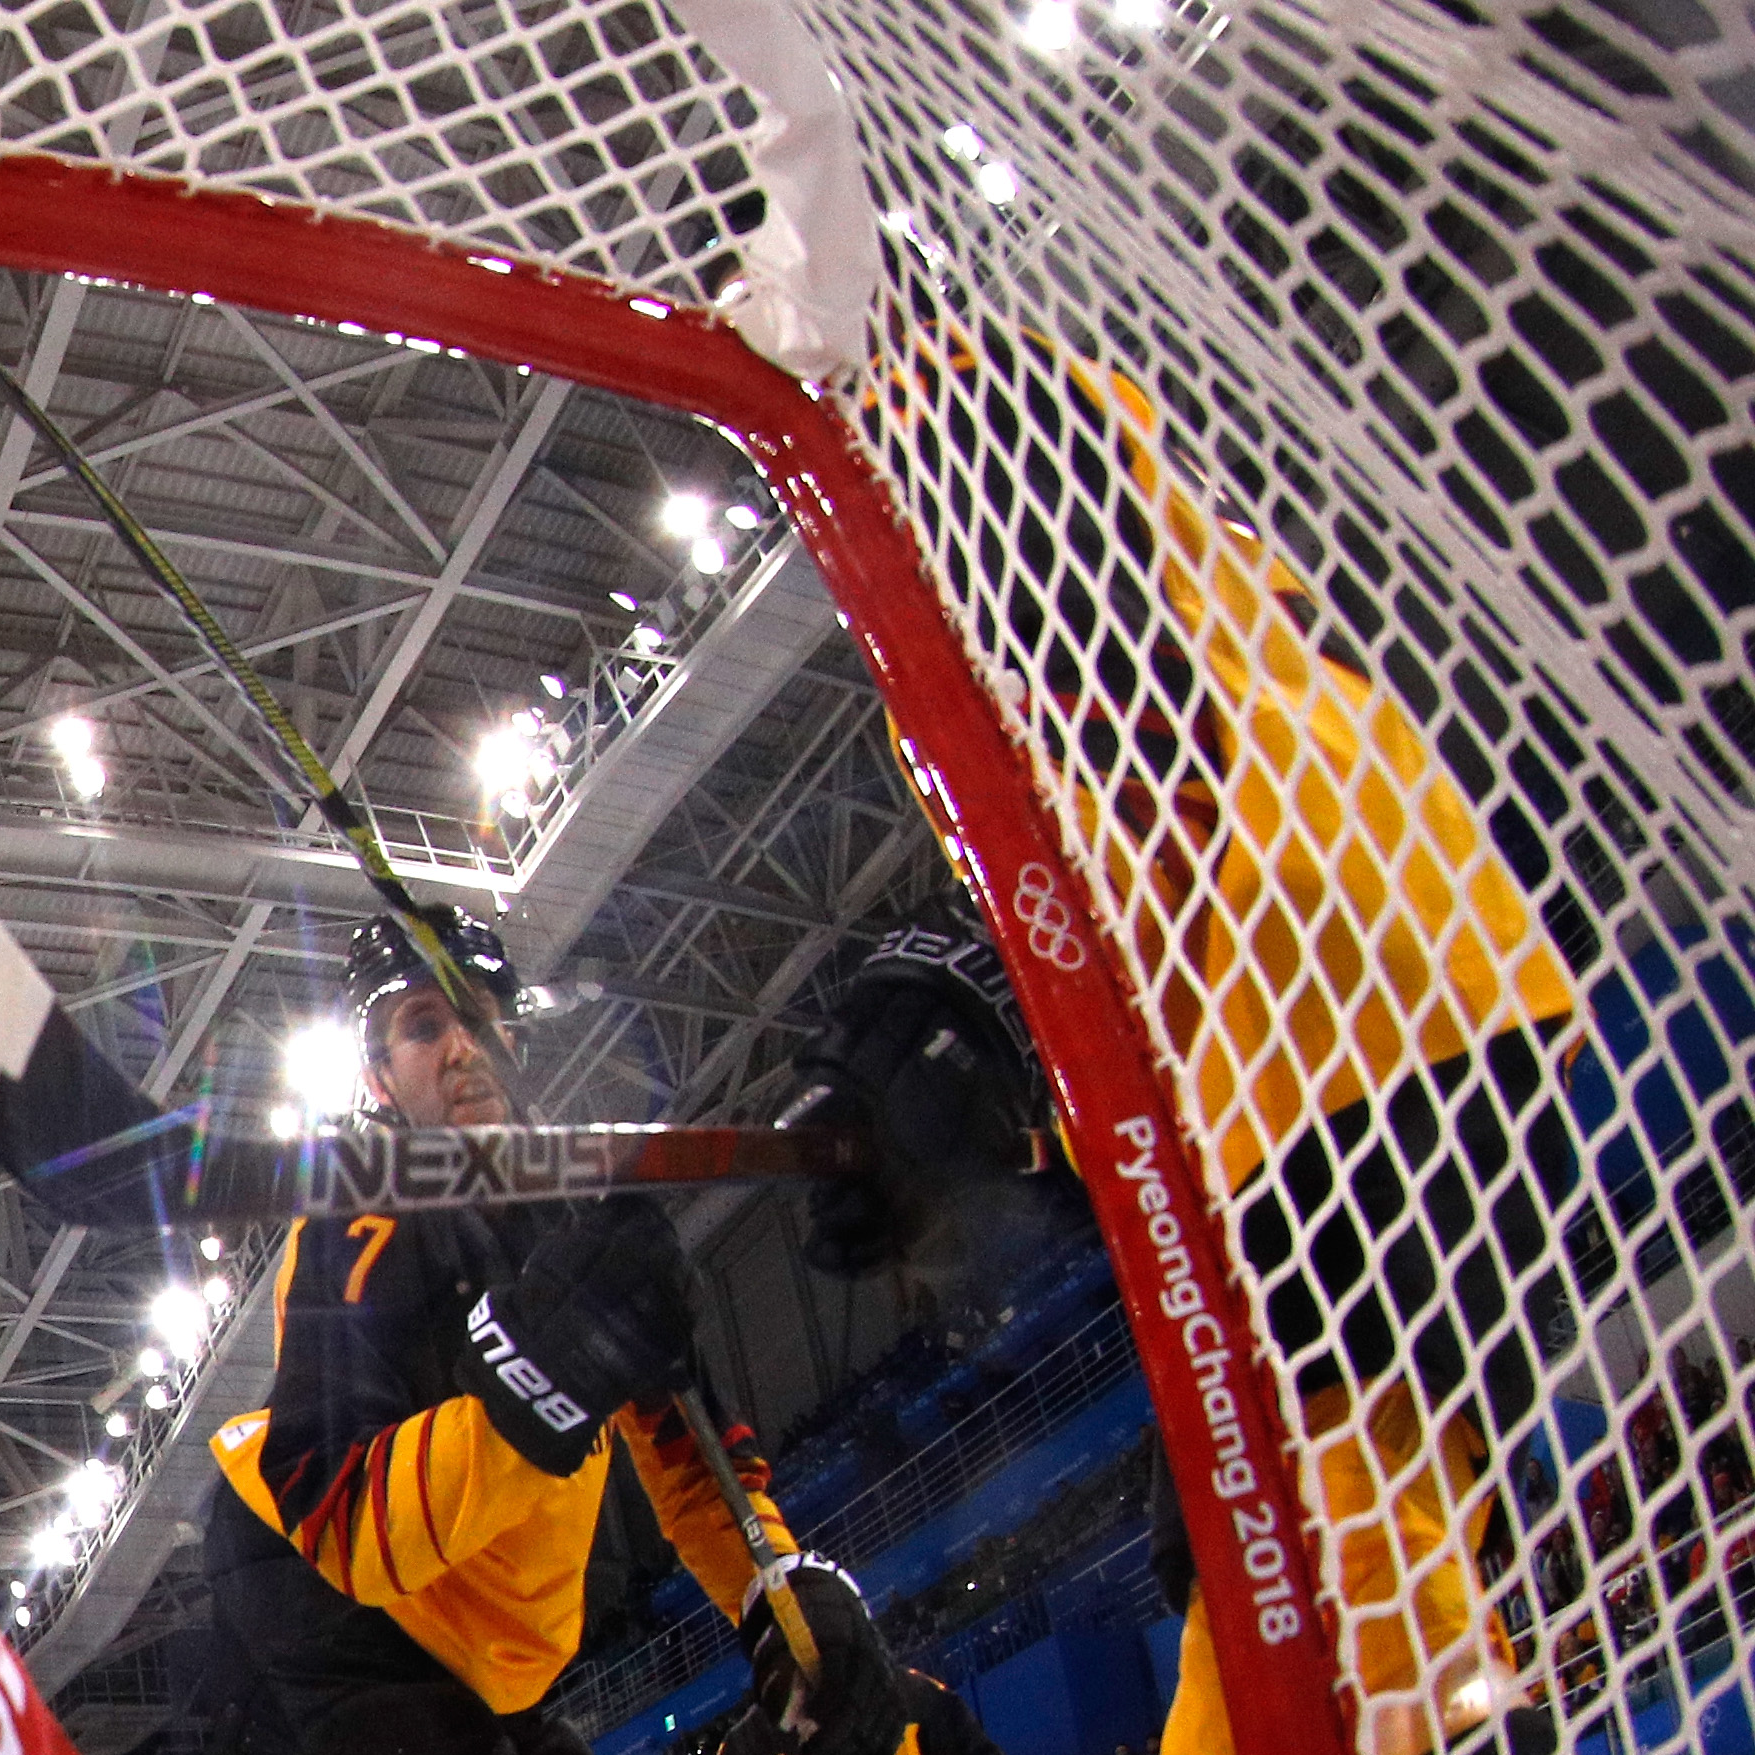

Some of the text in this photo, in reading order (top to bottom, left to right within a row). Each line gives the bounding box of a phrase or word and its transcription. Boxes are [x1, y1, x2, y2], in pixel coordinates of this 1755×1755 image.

[305, 1124, 612, 1214] NEXUS
[342, 1212, 398, 1304] 7
[467, 1291, 589, 1434] BAUE
[1112, 1114, 1302, 1648] PyeongChang 2018
